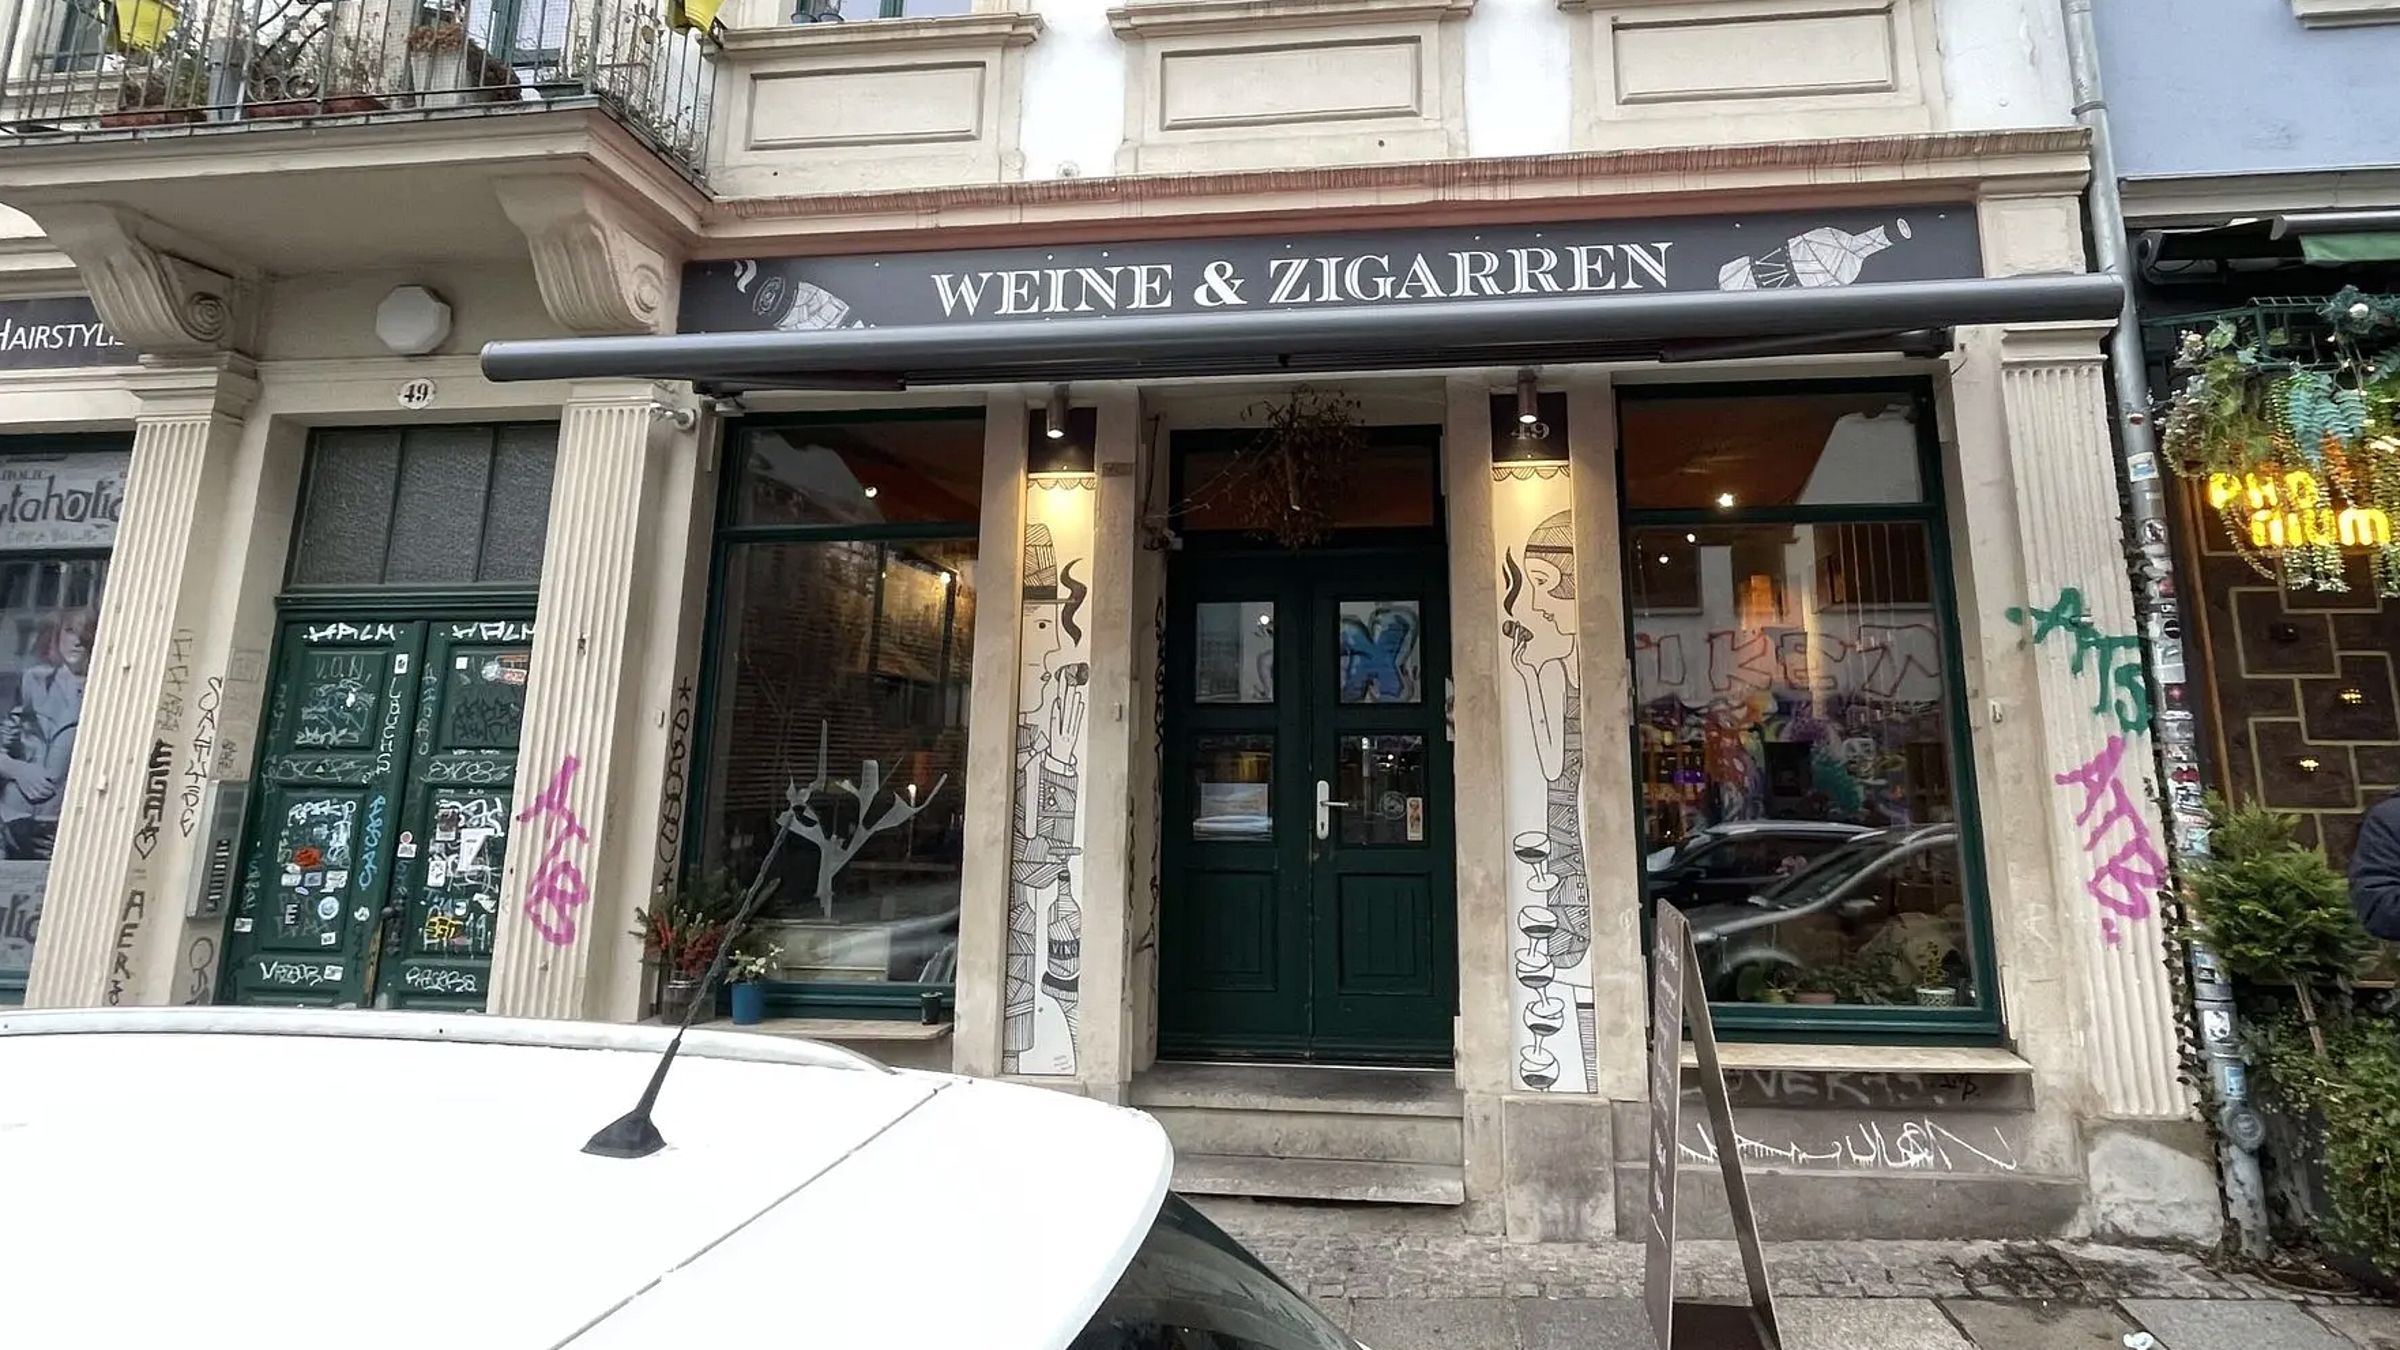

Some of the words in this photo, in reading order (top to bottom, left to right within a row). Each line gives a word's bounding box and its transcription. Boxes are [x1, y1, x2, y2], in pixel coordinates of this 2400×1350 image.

[931, 263, 1174, 319] WEINE
[1193, 259, 1247, 307] &
[1267, 241, 1674, 304] ZIGARREN
[404, 383, 428, 402] 49
